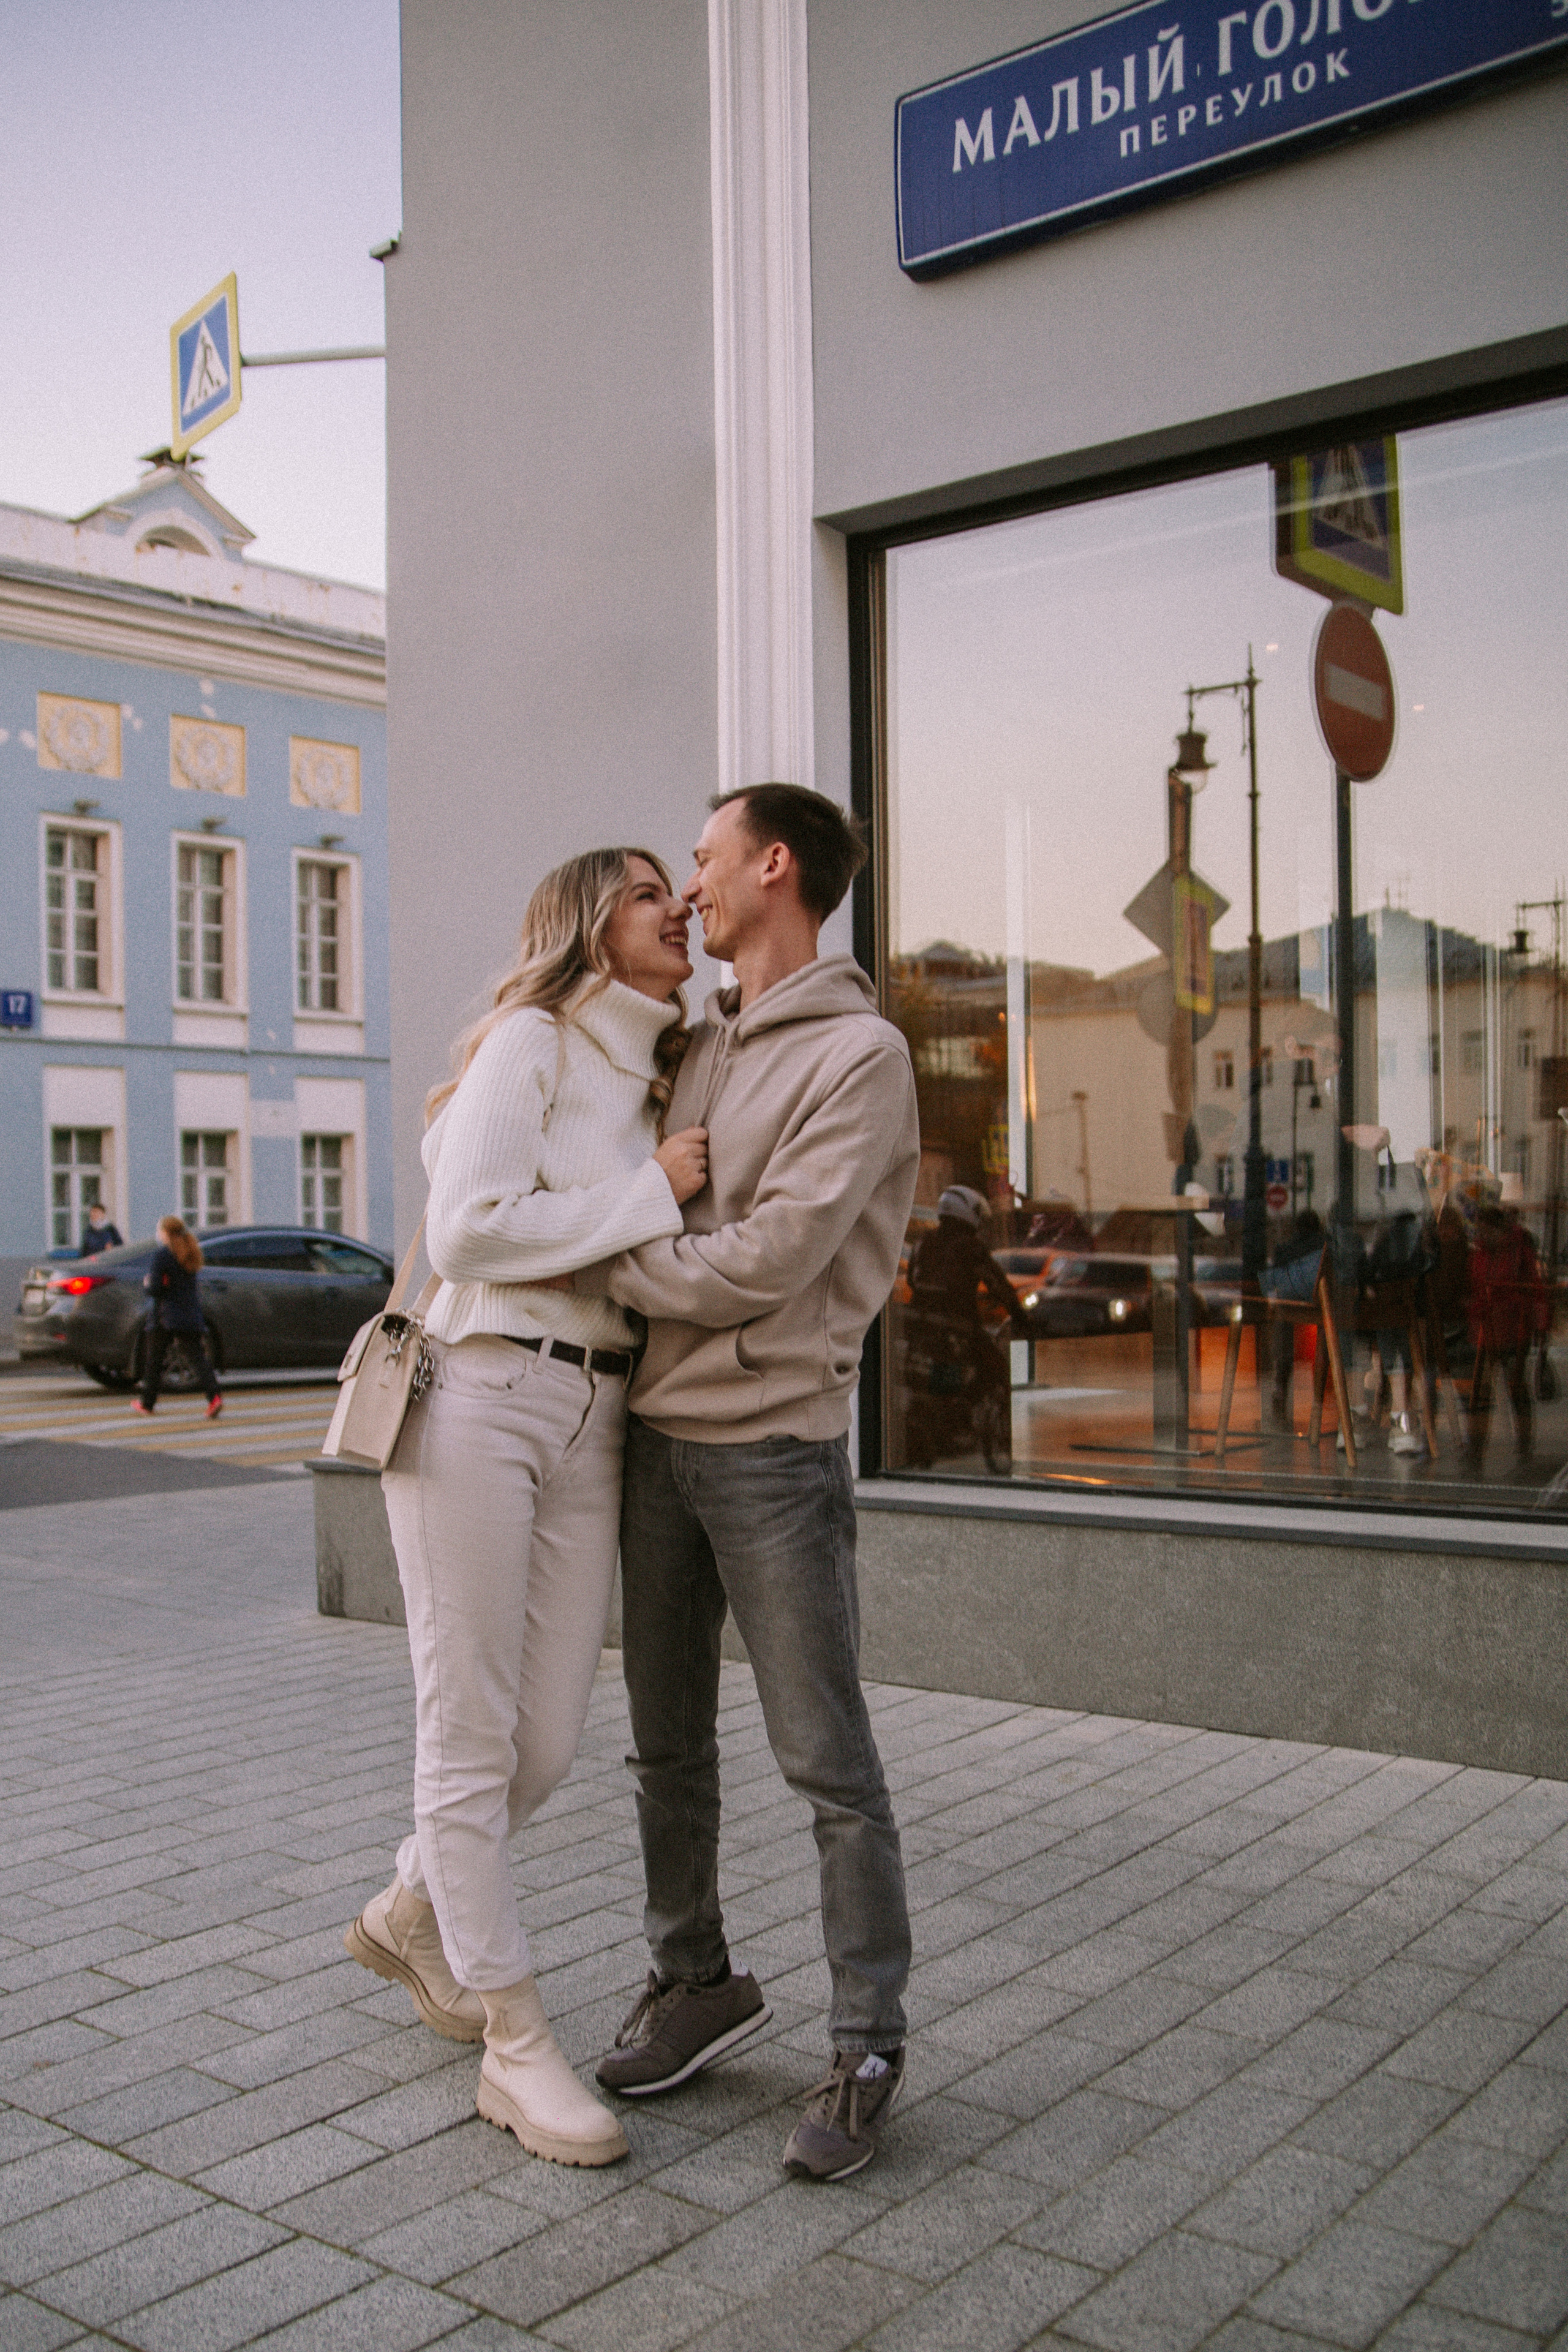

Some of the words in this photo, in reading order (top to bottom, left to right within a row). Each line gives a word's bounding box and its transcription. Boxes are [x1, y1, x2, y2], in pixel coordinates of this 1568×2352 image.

[952, 23, 1184, 173] МАЛЫЙ
[1120, 48, 1350, 158] ПЕРЕУЛОК
[9, 995, 25, 1014] 17
